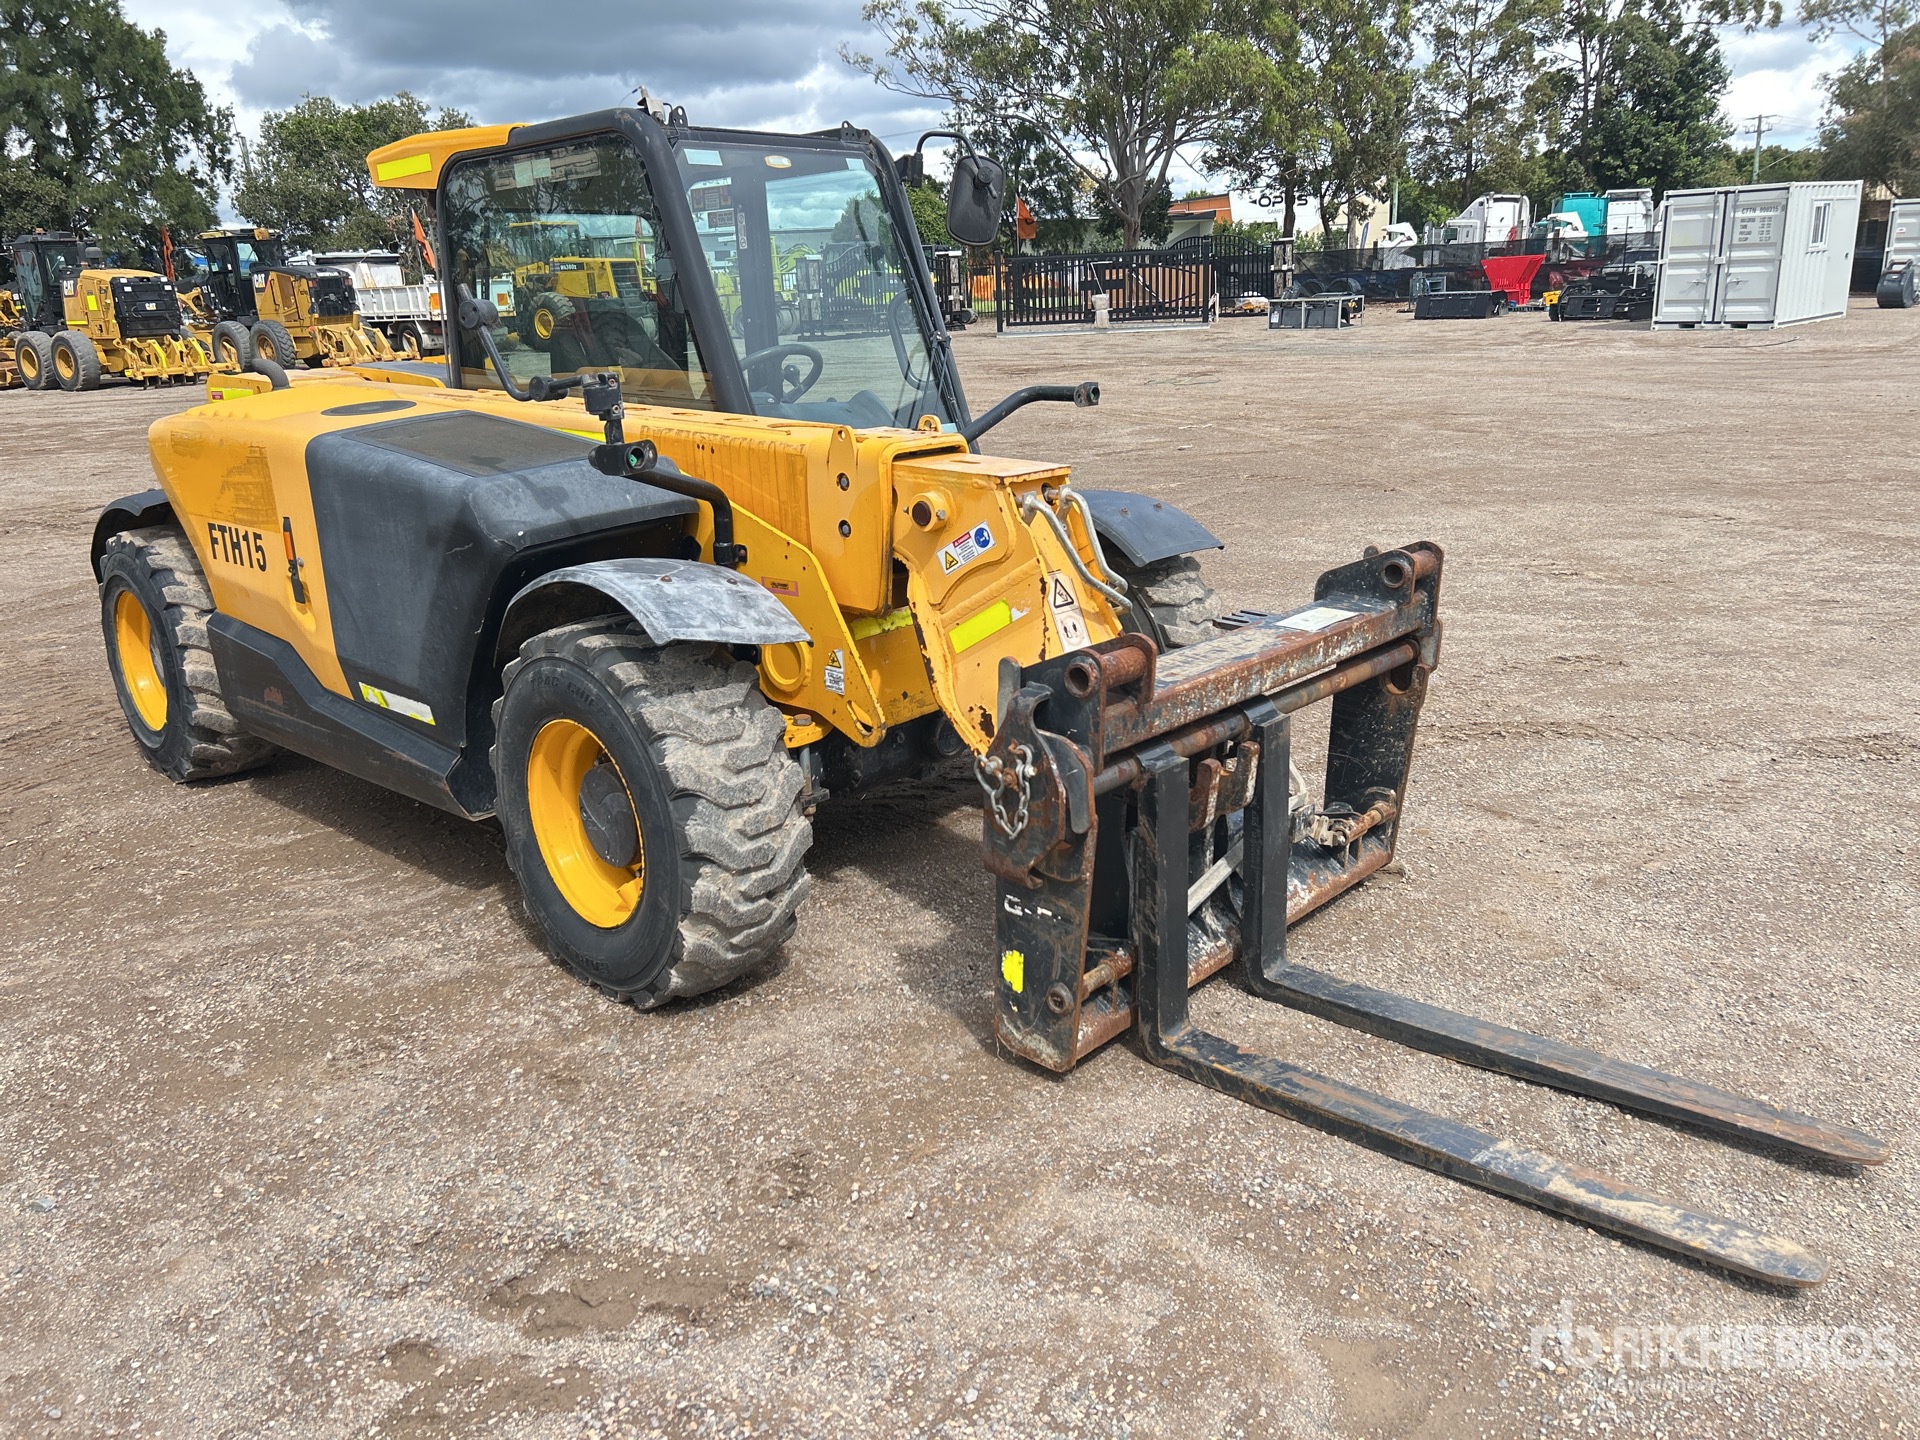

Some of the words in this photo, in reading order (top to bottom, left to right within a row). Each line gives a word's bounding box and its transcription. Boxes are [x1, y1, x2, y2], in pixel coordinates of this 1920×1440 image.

[1258, 195, 1308, 207] OPS
[64, 280, 75, 296] CAT
[254, 273, 266, 288] CAT
[145, 302, 157, 311] CAT
[207, 522, 267, 572] FTH15
